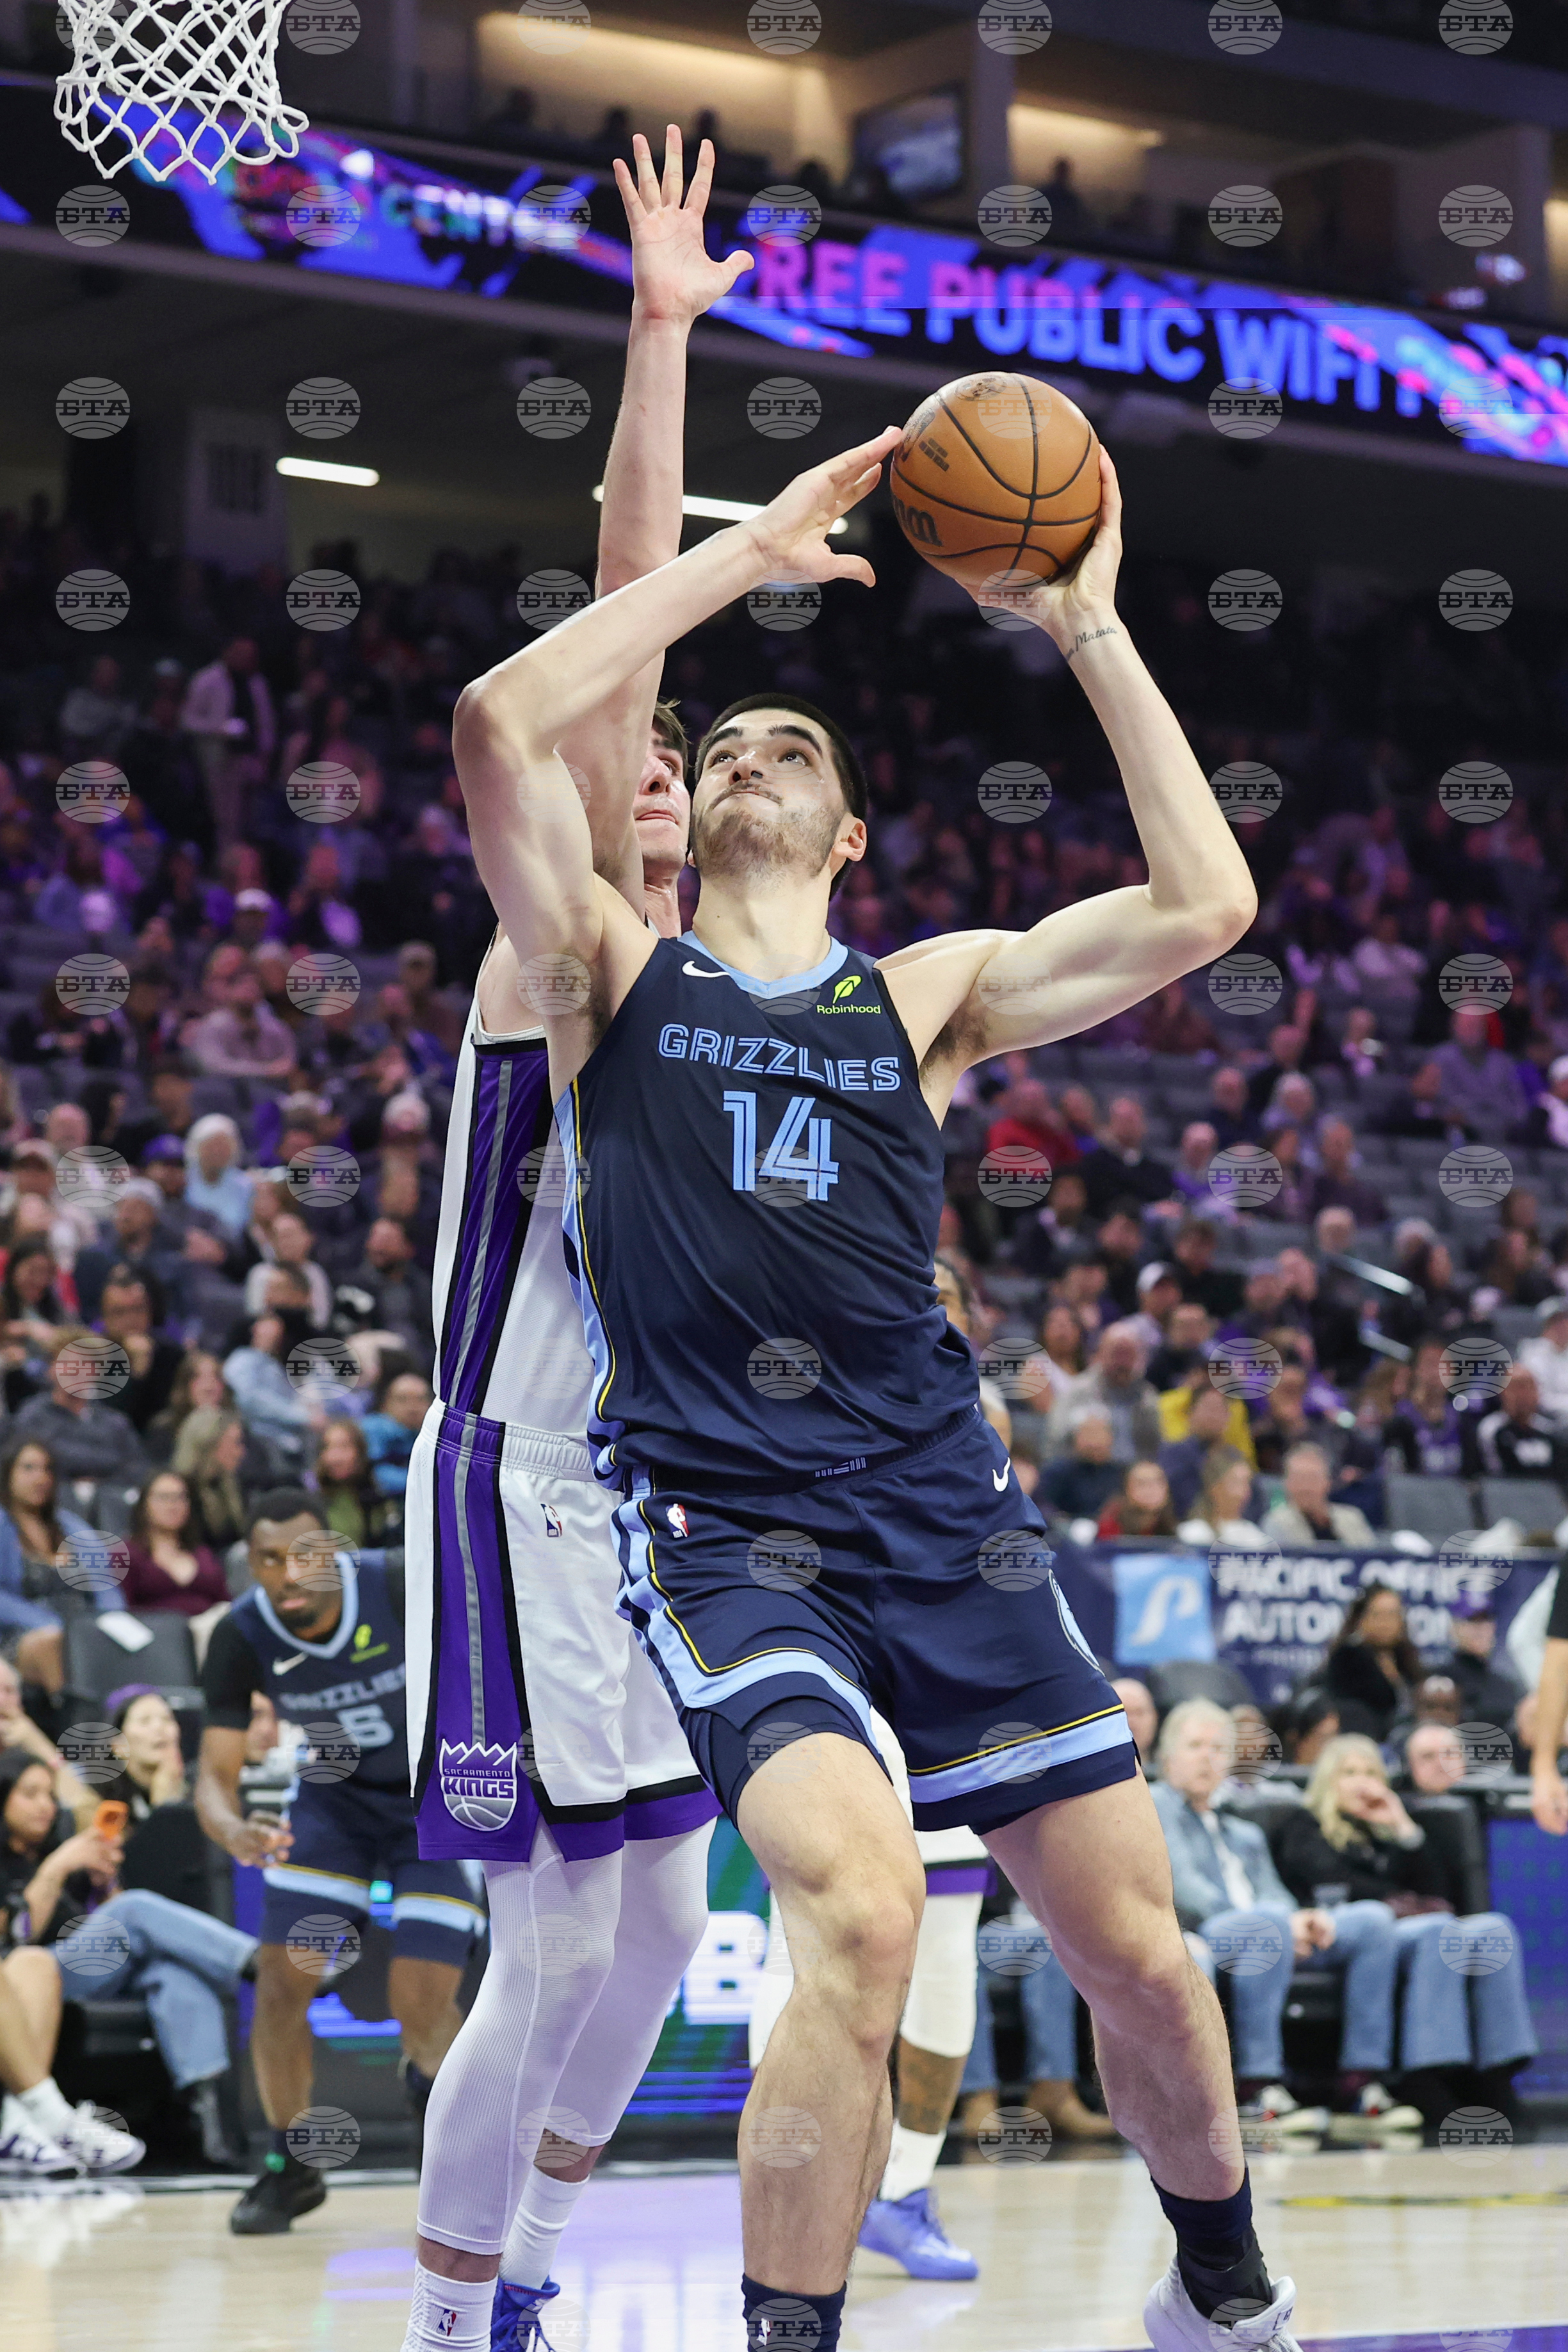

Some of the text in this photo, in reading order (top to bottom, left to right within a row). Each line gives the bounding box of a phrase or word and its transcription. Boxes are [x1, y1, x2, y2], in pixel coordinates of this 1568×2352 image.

[756, 238, 912, 337] REE
[925, 260, 1206, 383] PUBLIC
[816, 1003, 882, 1015] Robinhood
[658, 1023, 901, 1092] GRIZZLIES
[723, 1090, 839, 1202] 14
[444, 1768, 510, 1778] SACRAMENTO
[444, 1778, 514, 1799] KINGS
